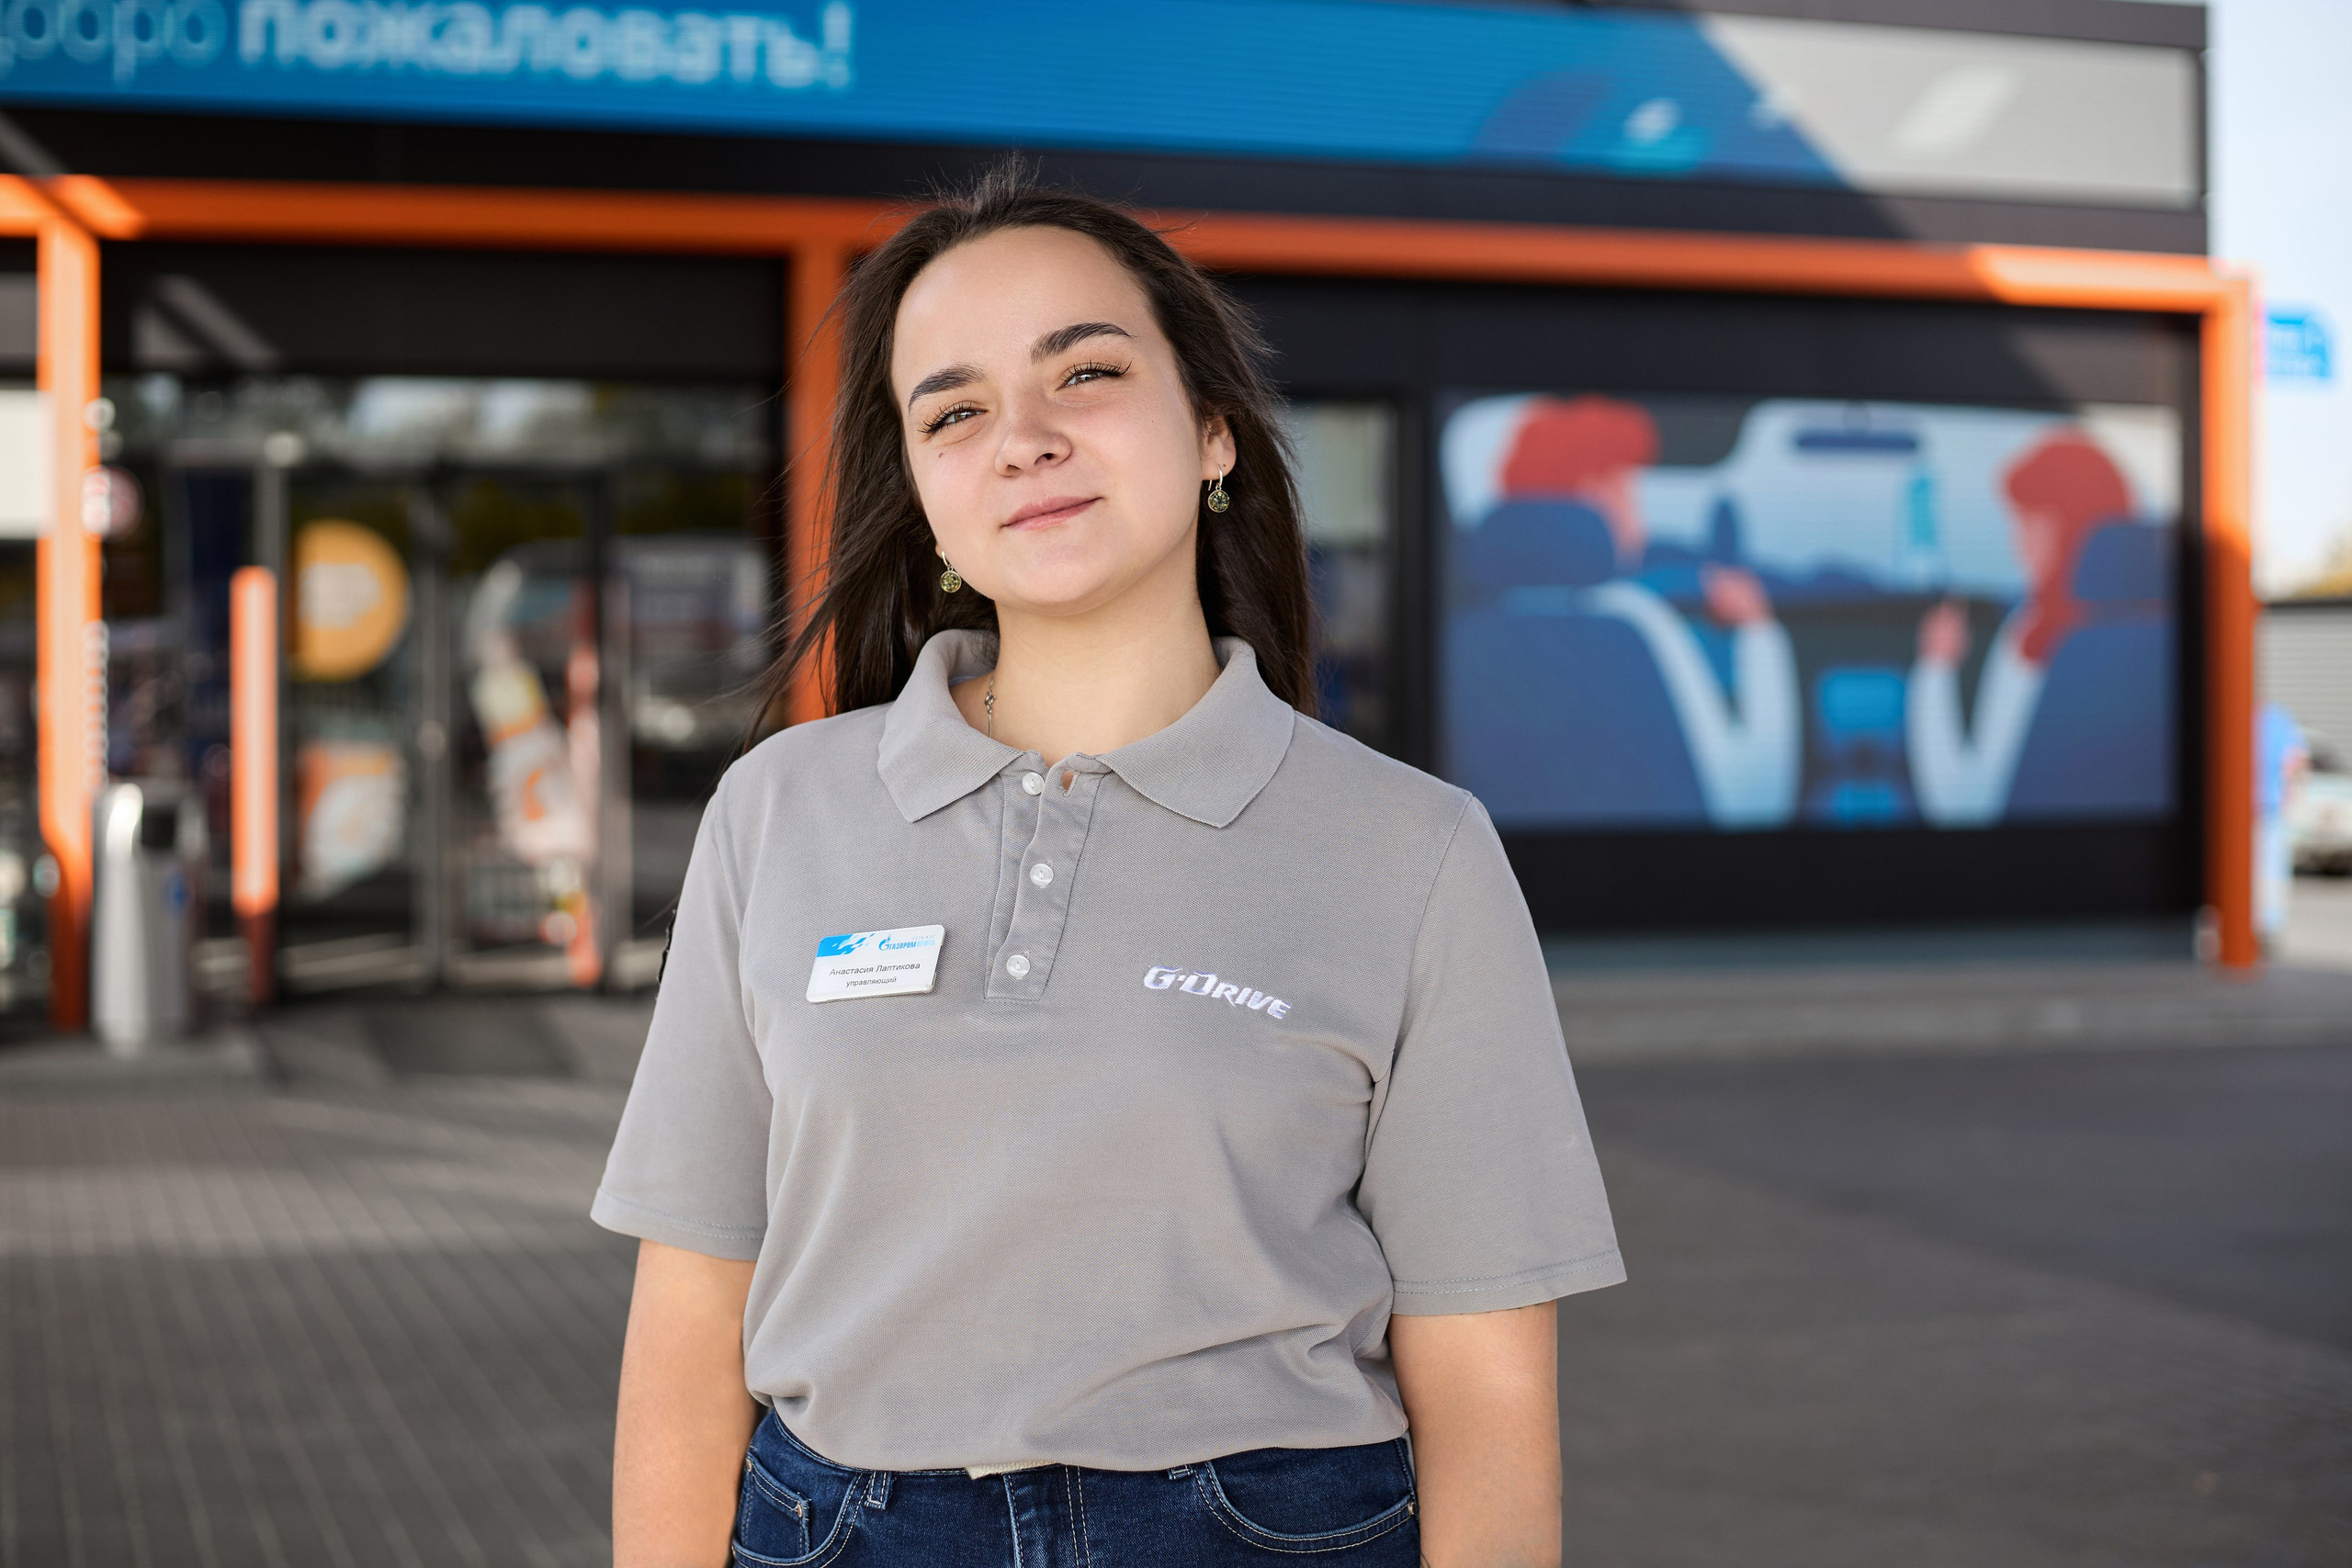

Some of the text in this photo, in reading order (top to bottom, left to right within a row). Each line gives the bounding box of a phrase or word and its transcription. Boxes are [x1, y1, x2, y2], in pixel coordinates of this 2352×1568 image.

[0, 0, 853, 90] обро пожаловать!
[829, 963, 921, 976] Анастасия Лаптикова
[846, 976, 897, 987] управляющий
